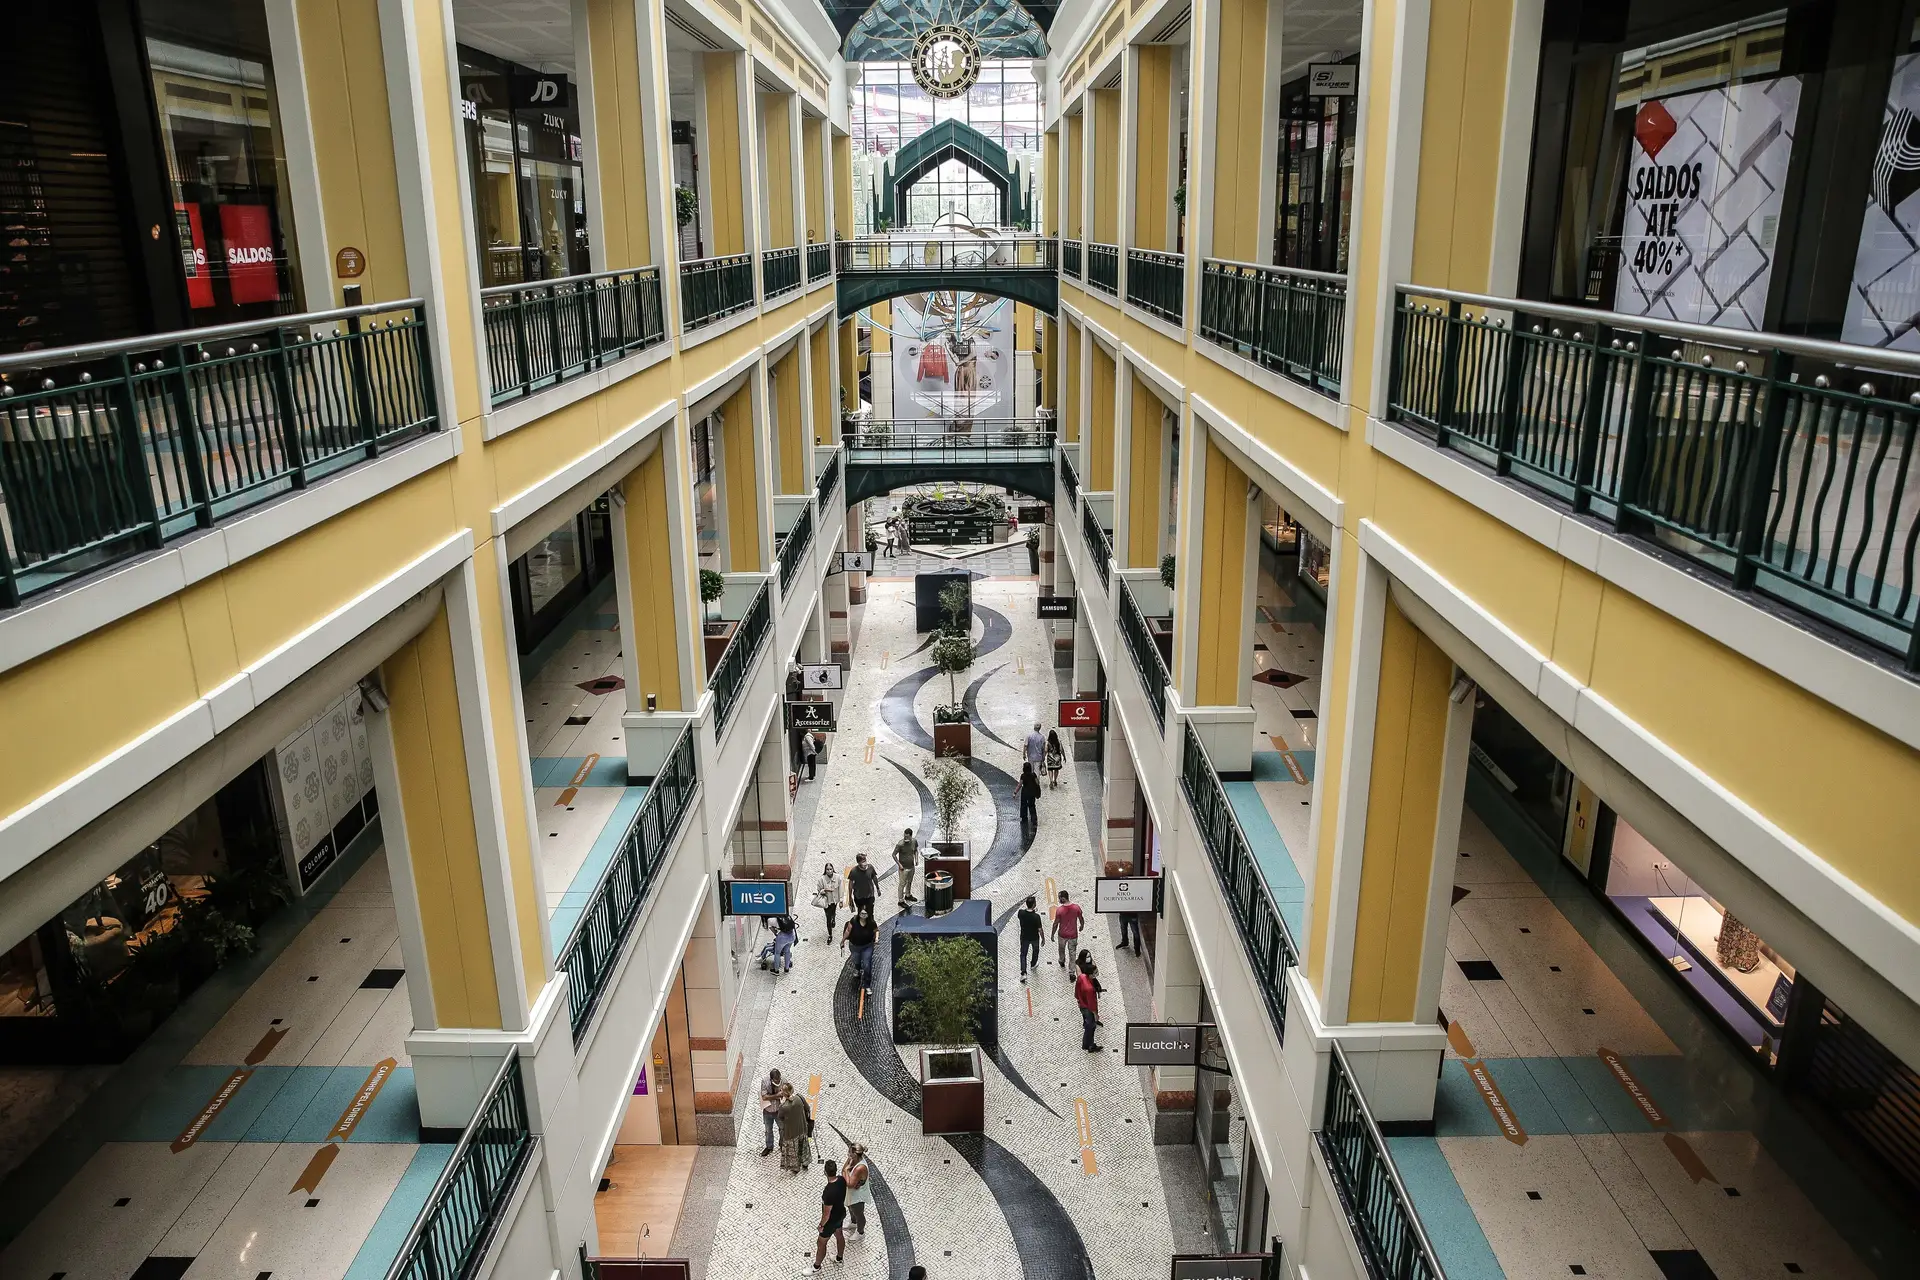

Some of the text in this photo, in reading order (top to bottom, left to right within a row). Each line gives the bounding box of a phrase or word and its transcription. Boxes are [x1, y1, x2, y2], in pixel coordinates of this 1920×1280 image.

[530, 79, 558, 102] JD
[543, 113, 565, 130] ZUKY
[550, 188, 567, 200] ZUKY
[1634, 162, 1702, 200] SALDOS
[1645, 199, 1679, 237] ATÉ
[228, 246, 273, 264] SALDOS
[304, 844, 329, 873] COLOMBO
[740, 892, 776, 904] MEO
[338, 1065, 389, 1132] CAMINHE PELA DIREITA
[1472, 1068, 1519, 1136] CAMINHE PELA DIREITA
[1606, 1055, 1662, 1121] CAMINHE PELA DIREITA
[181, 1074, 244, 1143] CAMINHE PELA DIREITA
